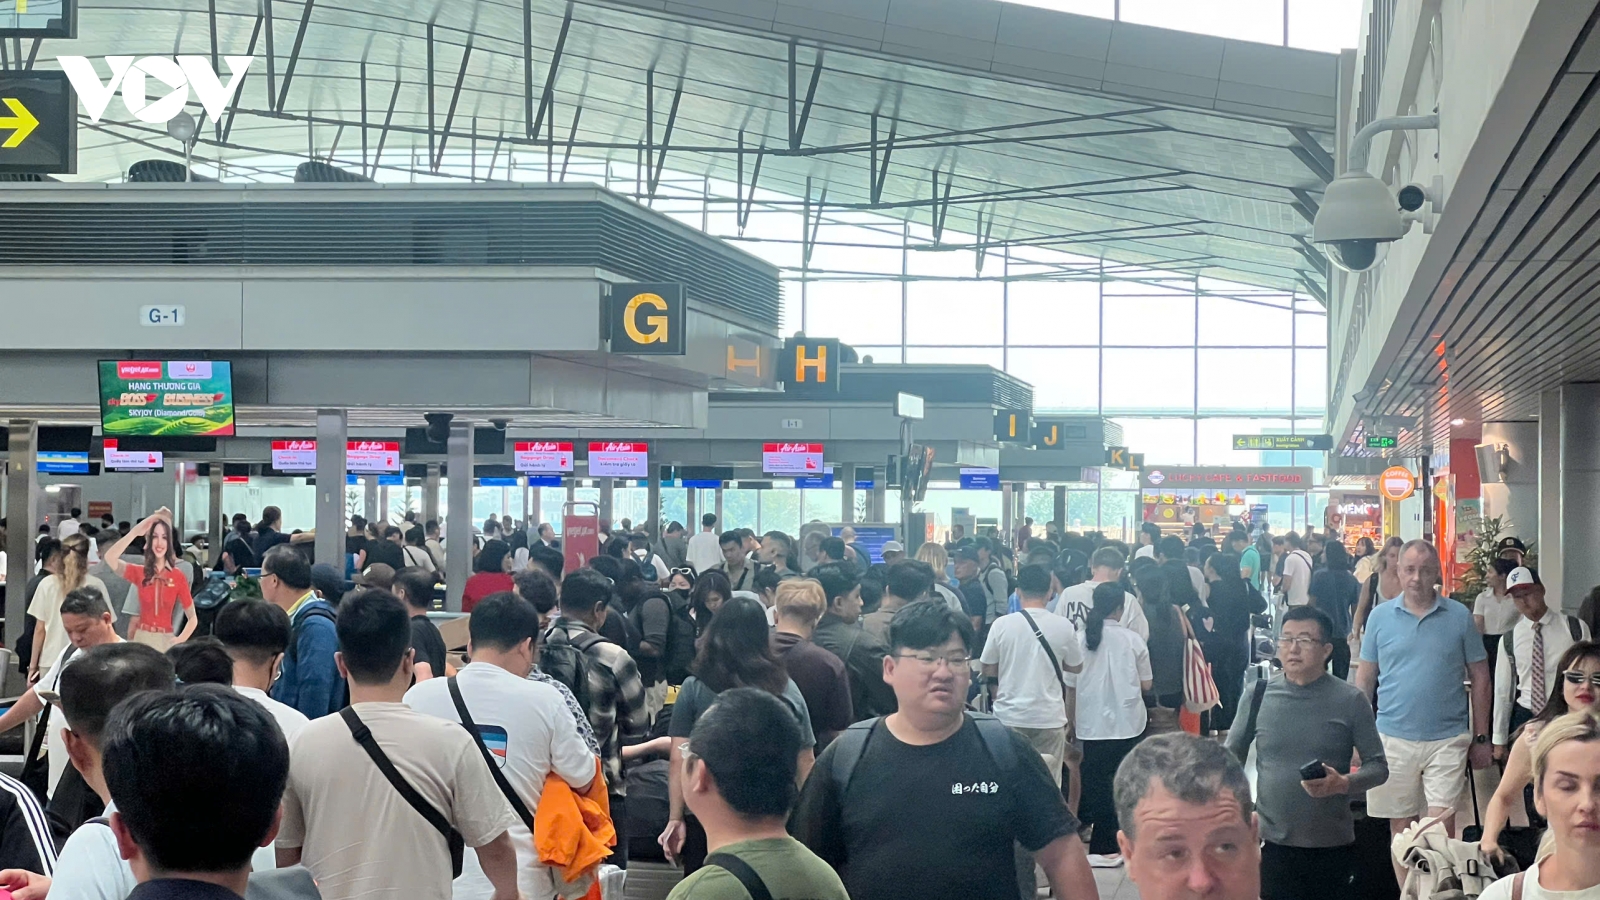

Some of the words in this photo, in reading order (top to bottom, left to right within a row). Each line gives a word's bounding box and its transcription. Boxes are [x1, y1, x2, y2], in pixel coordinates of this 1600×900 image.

[148, 308, 178, 323] G-1
[623, 292, 668, 344] G
[795, 345, 827, 382] H
[128, 382, 151, 392] HẠNG
[187, 382, 201, 391] GIA
[128, 409, 152, 417] SKYJOY
[1009, 414, 1016, 437] I
[1044, 425, 1058, 446] J
[1111, 449, 1123, 465] K
[1129, 456, 1140, 470] L
[1205, 473, 1232, 483] CAFE
[1246, 473, 1303, 483] FASTFOOD
[1384, 470, 1409, 478] COFFEE
